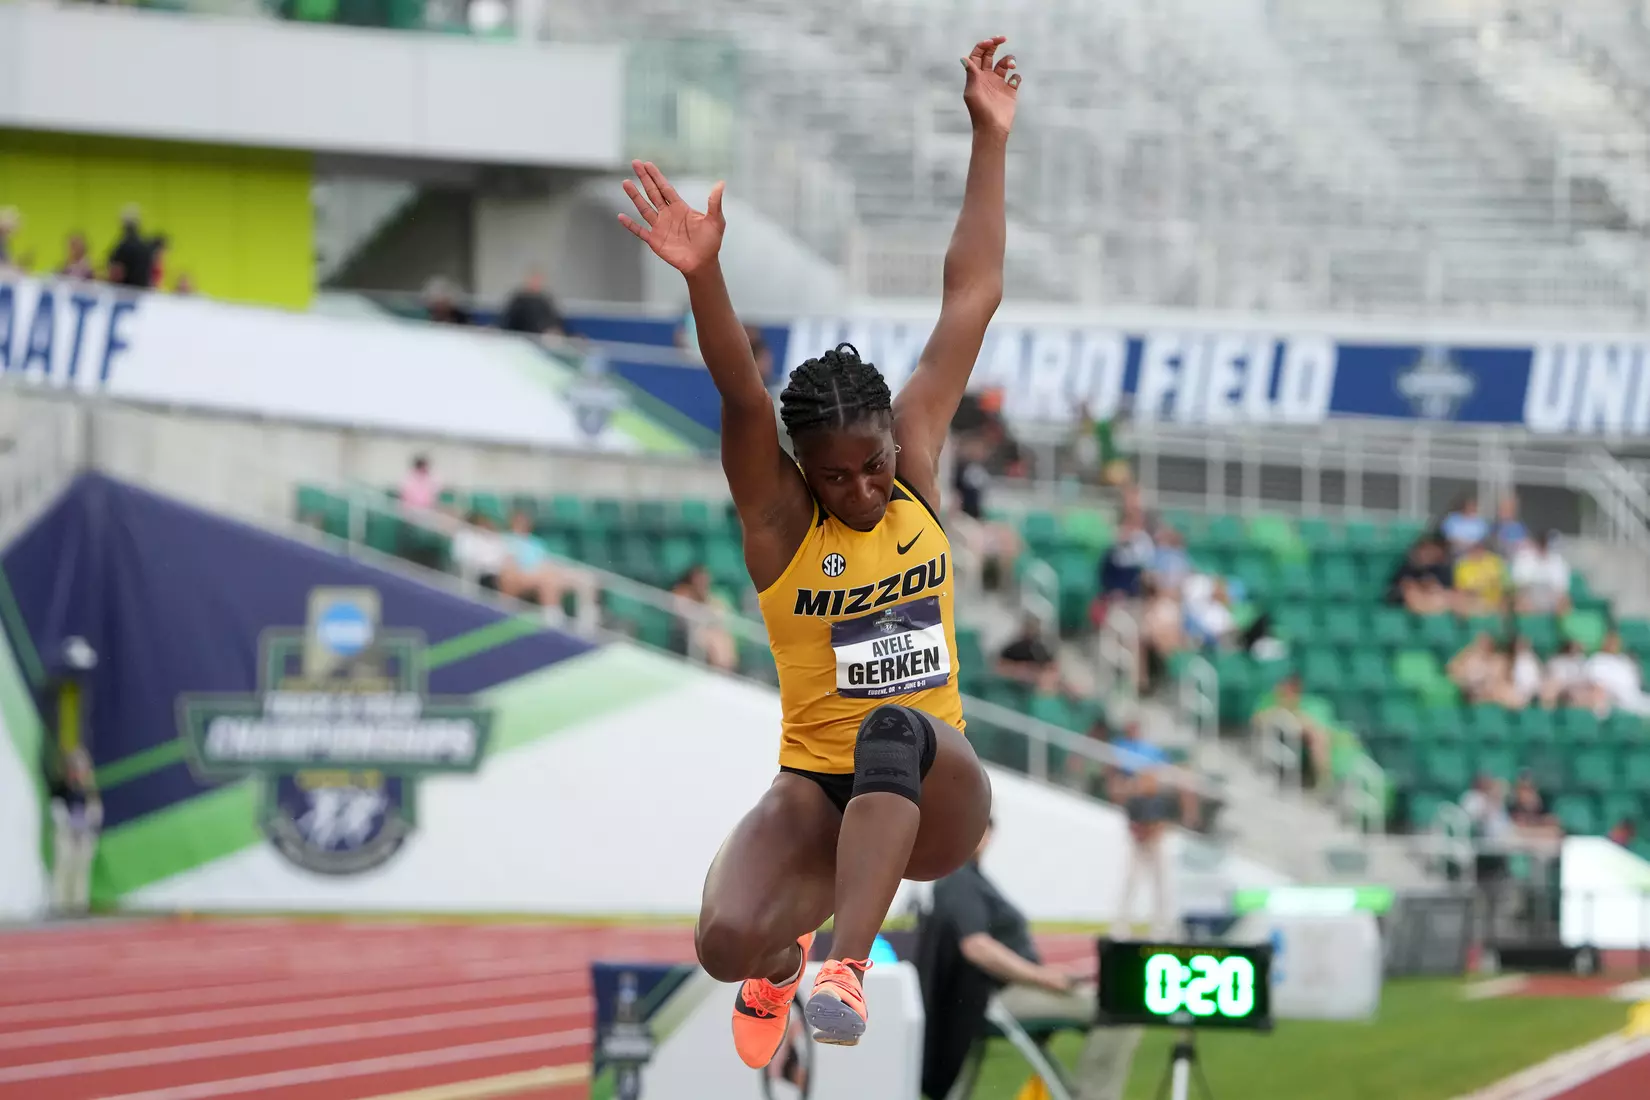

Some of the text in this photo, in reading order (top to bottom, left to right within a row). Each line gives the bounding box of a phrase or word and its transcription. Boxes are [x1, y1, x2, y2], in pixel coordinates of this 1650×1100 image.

[1136, 330, 1336, 423] FIELD
[793, 553, 947, 617] MIZZOU
[823, 555, 846, 577] SEC
[872, 633, 914, 658] AYELE
[847, 646, 941, 685] GERKEN
[903, 681, 916, 690] JUNE
[1144, 953, 1254, 1017] 0:20
